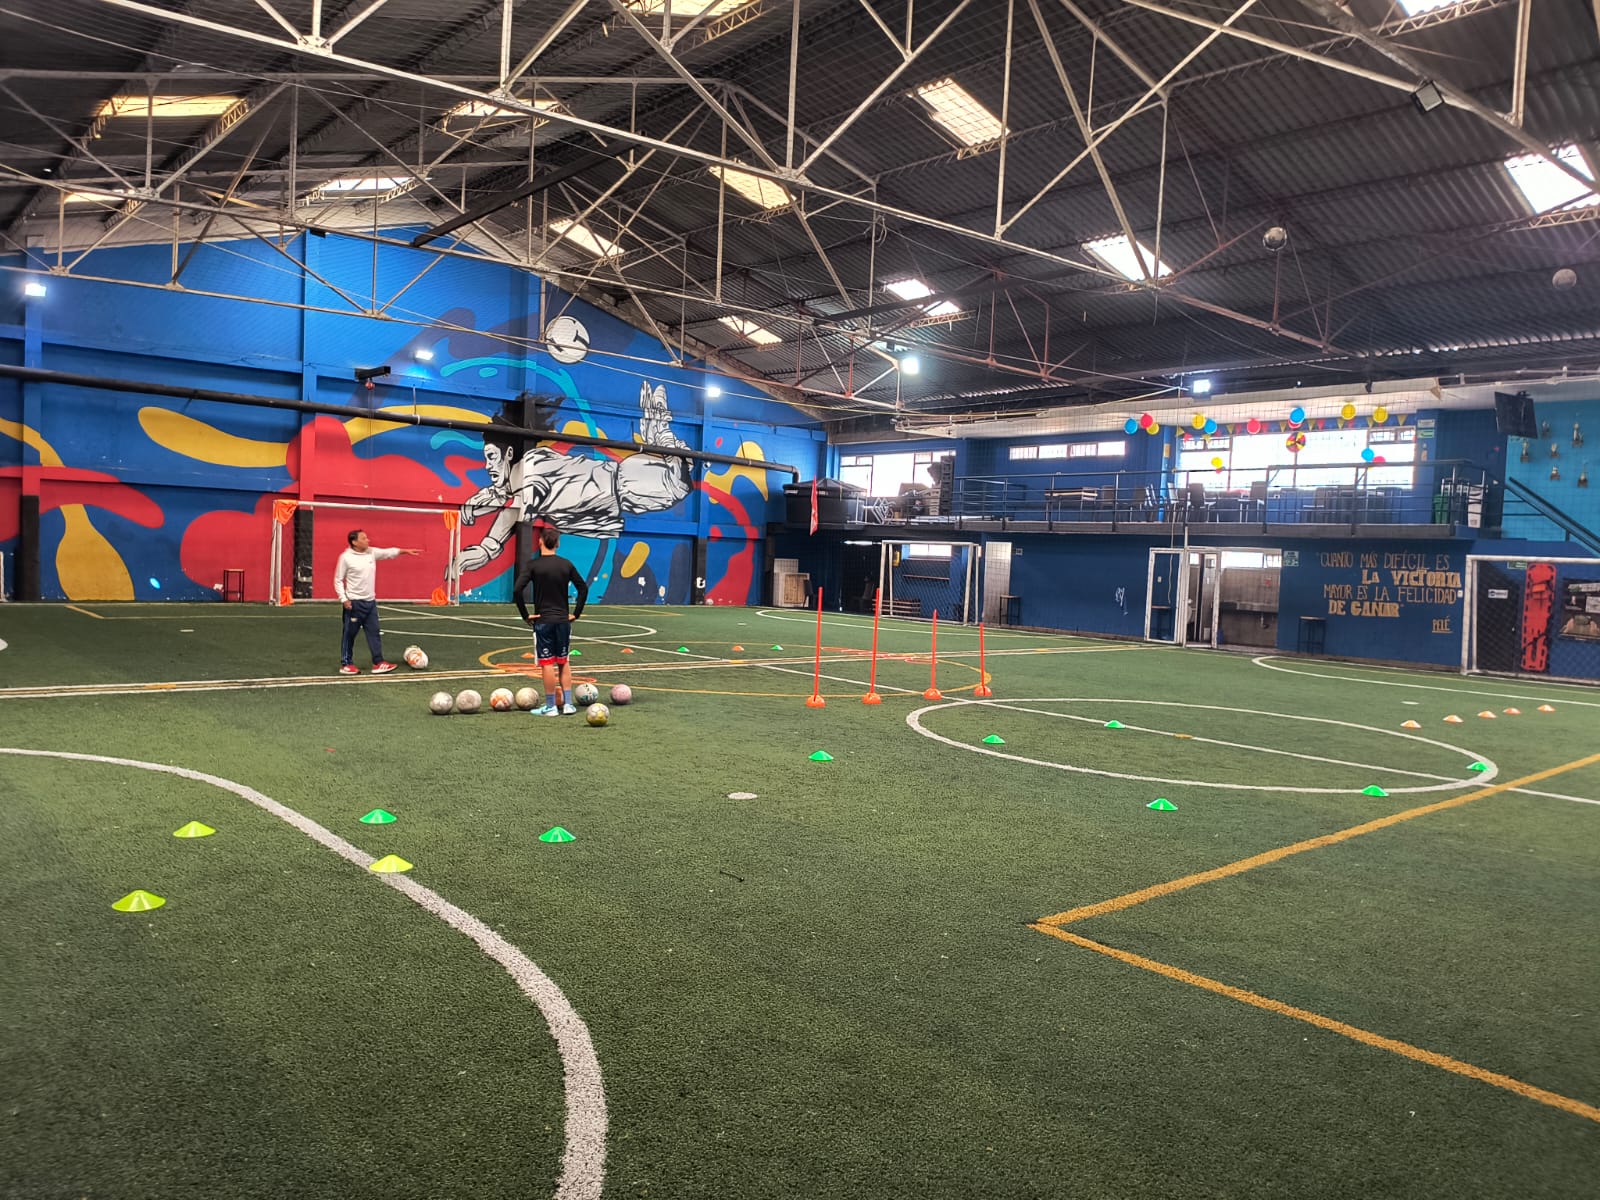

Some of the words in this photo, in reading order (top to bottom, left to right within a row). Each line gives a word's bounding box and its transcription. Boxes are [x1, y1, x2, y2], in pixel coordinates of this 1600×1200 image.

[1435, 554, 1450, 570] ES
[1362, 569, 1380, 585] LA
[1391, 569, 1462, 588] VICTORIA
[1323, 584, 1352, 599] MAYOR
[1357, 585, 1368, 600] ES
[1375, 586, 1390, 601] LA
[1398, 587, 1457, 605] FELICIDAD
[1328, 599, 1346, 615] DE
[1432, 615, 1450, 631] PELÉ
